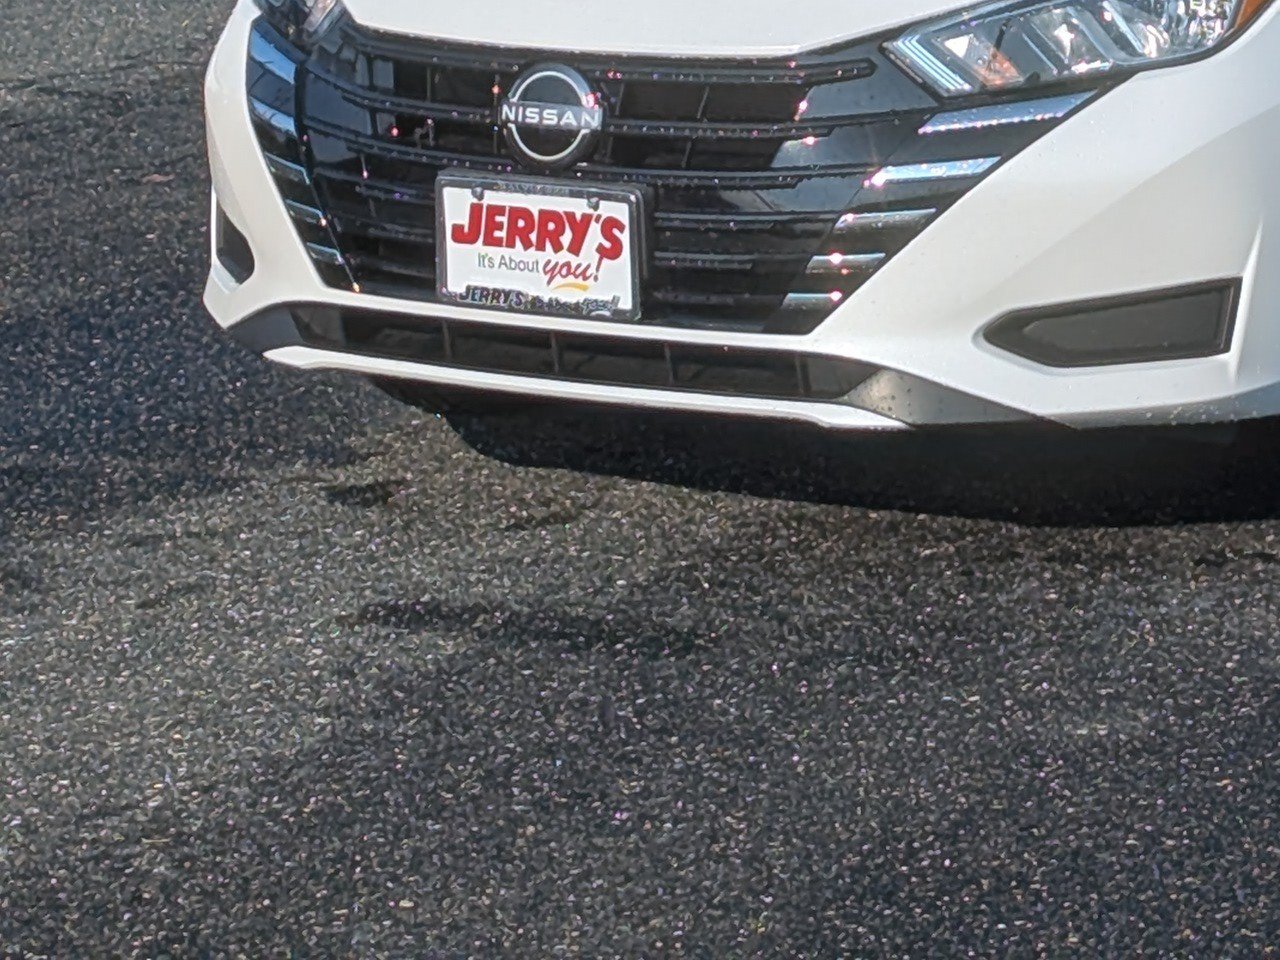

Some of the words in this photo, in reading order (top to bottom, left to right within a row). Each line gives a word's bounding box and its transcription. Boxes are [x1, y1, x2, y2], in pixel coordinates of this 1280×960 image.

[501, 104, 600, 130] NISSAN
[451, 202, 626, 261] JERRY'S
[477, 252, 495, 268] It's
[498, 255, 540, 273] About
[542, 254, 605, 287] you!
